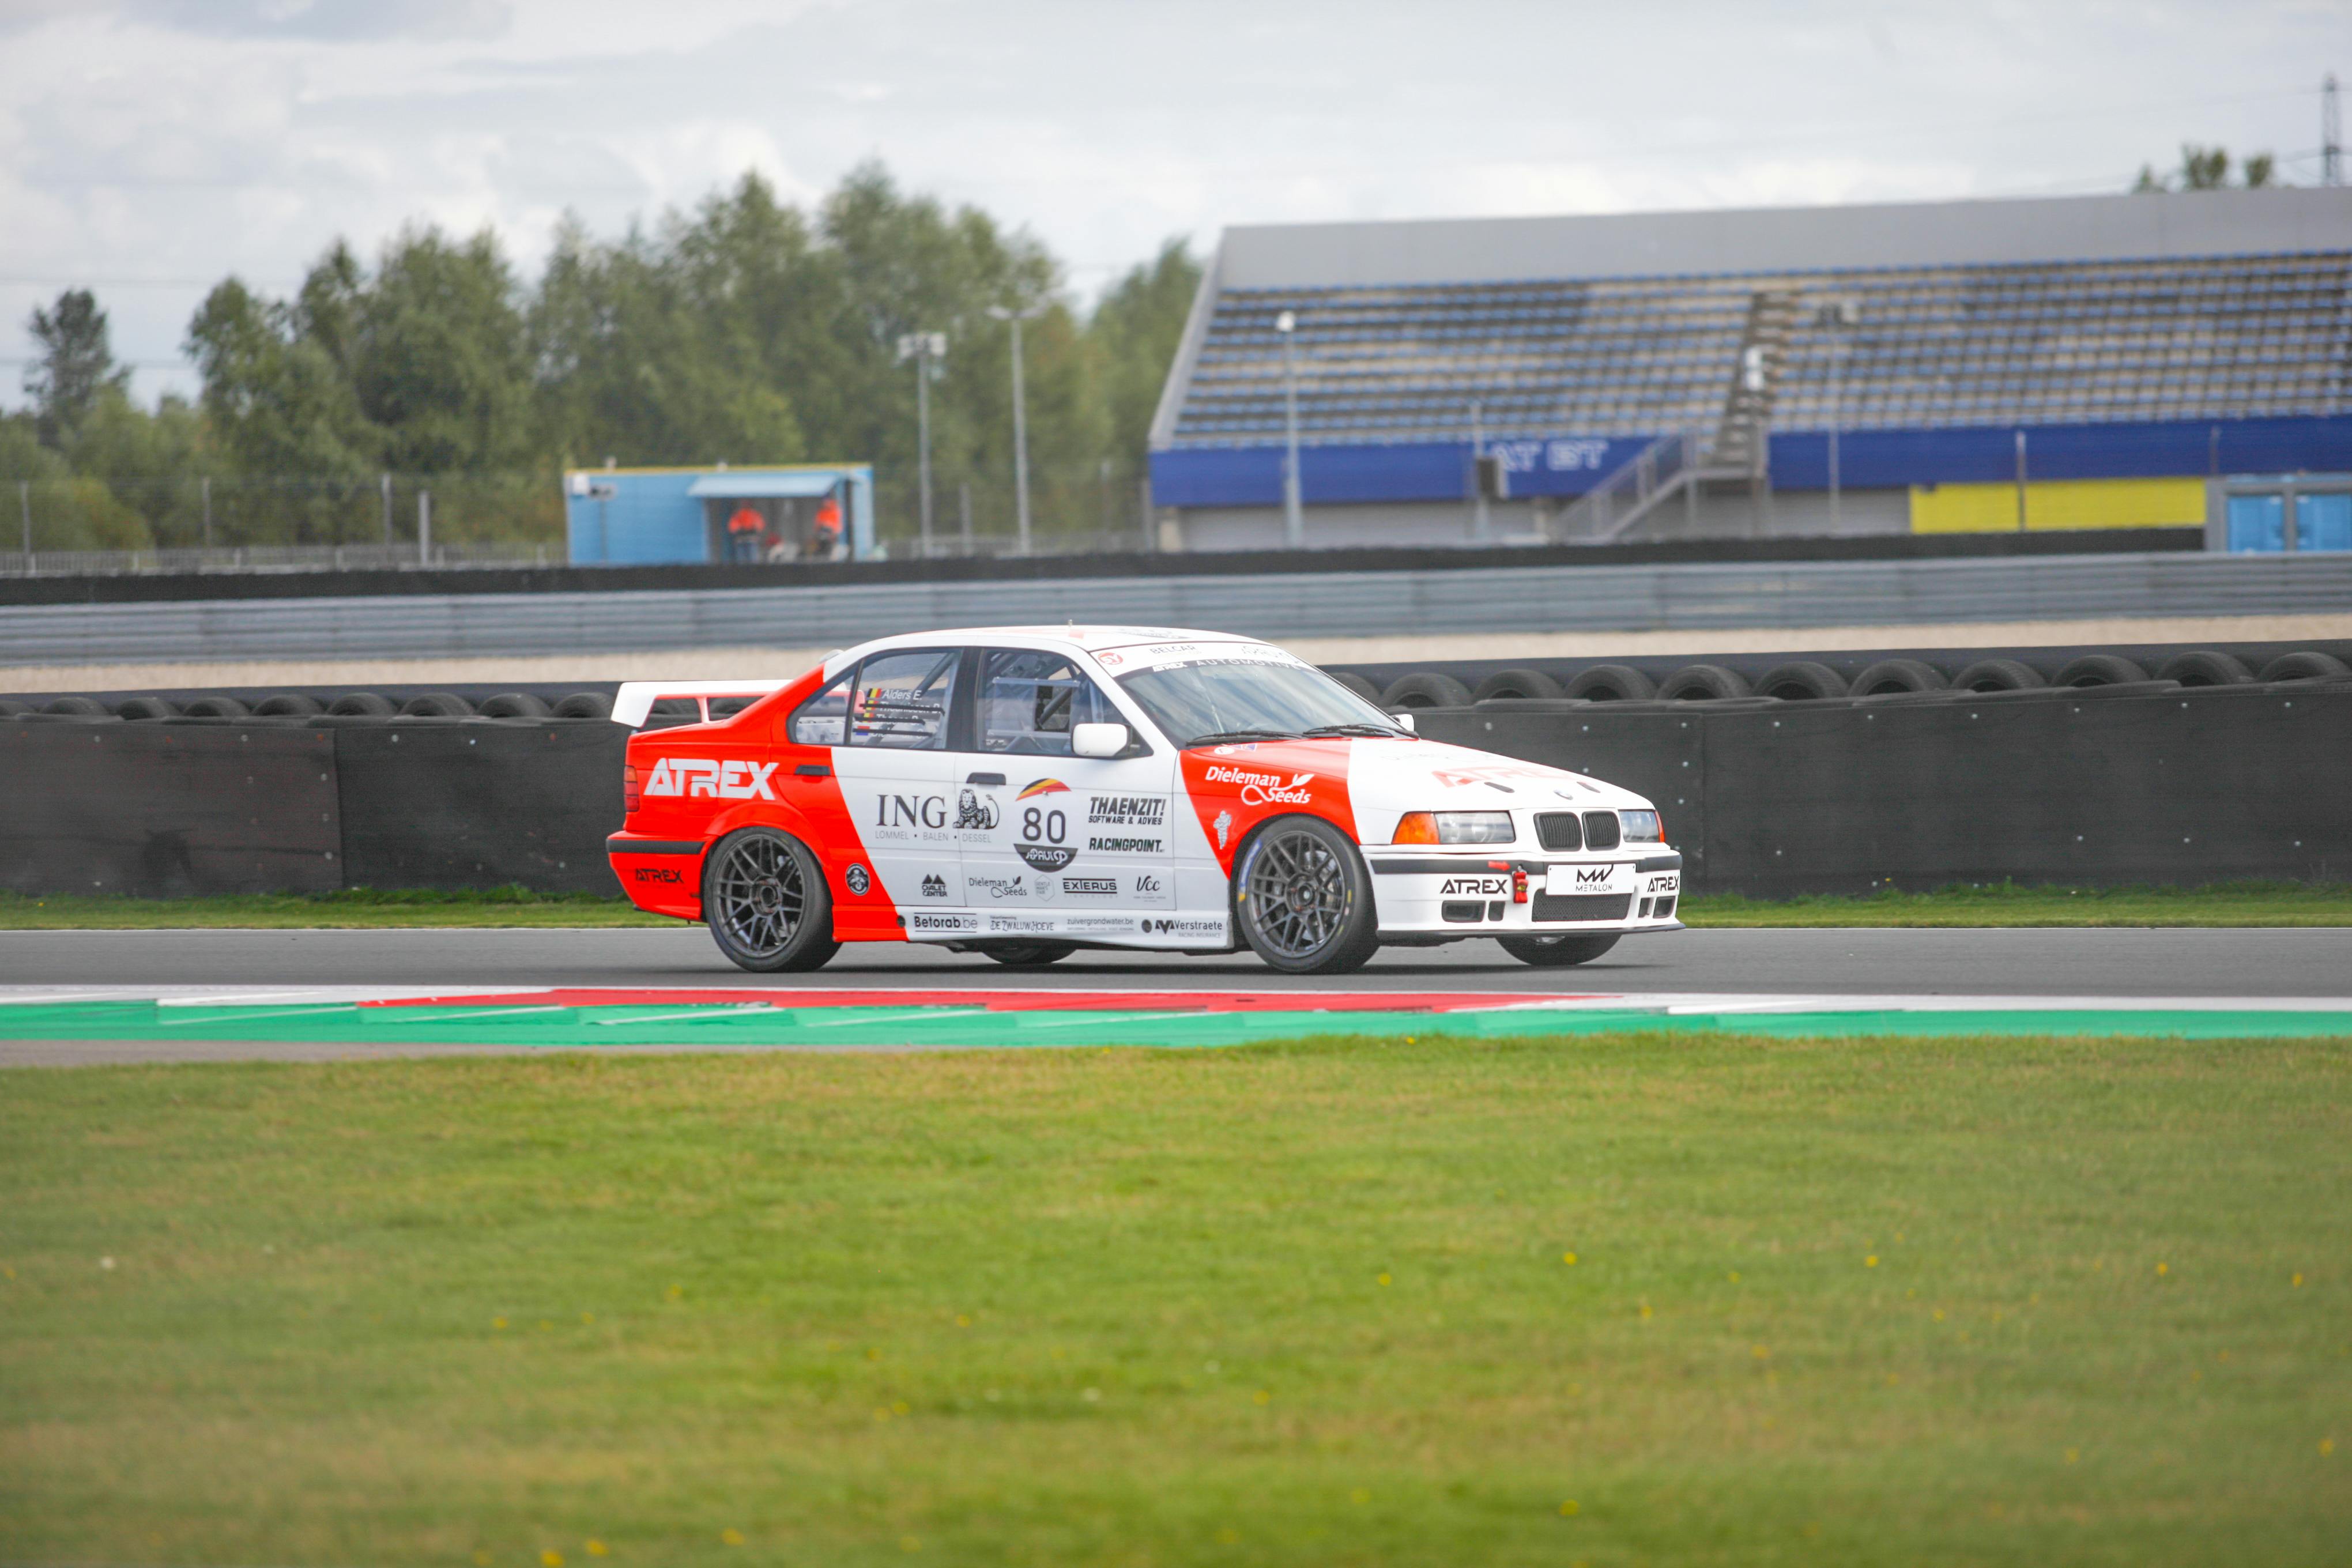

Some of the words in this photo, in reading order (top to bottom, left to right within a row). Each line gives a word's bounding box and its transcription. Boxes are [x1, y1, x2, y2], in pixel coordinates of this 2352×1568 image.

[1149, 645, 1196, 654] BELCAR
[1152, 662, 1188, 672] ATREX
[1196, 659, 1301, 671] AUTOMOTIVE
[882, 689, 911, 700] Alders
[913, 690, 922, 700] E.
[643, 757, 779, 801] ATREX
[1205, 766, 1281, 787] Dieleman
[1268, 787, 1311, 804] Seeds
[876, 794, 947, 829] ING
[1090, 797, 1167, 816] THAENZIT!
[1023, 807, 1065, 844] 80
[1088, 816, 1125, 824] SOFTWARE
[875, 831, 909, 840] LOMMEL
[923, 832, 949, 841] BALEN
[962, 834, 992, 843] DESSEL
[636, 868, 684, 884] ATREX
[968, 877, 1007, 887] Dieleman
[1063, 881, 1117, 891] EXTERUS
[1440, 879, 1508, 894] ATREX
[1575, 884, 1612, 892] METALON
[1647, 876, 1679, 892] ATREX
[914, 916, 978, 929] Betorab.be
[990, 920, 1001, 930] DE
[1067, 918, 1134, 926] zuivergrondwater.be
[1174, 920, 1222, 930] Verstraete
